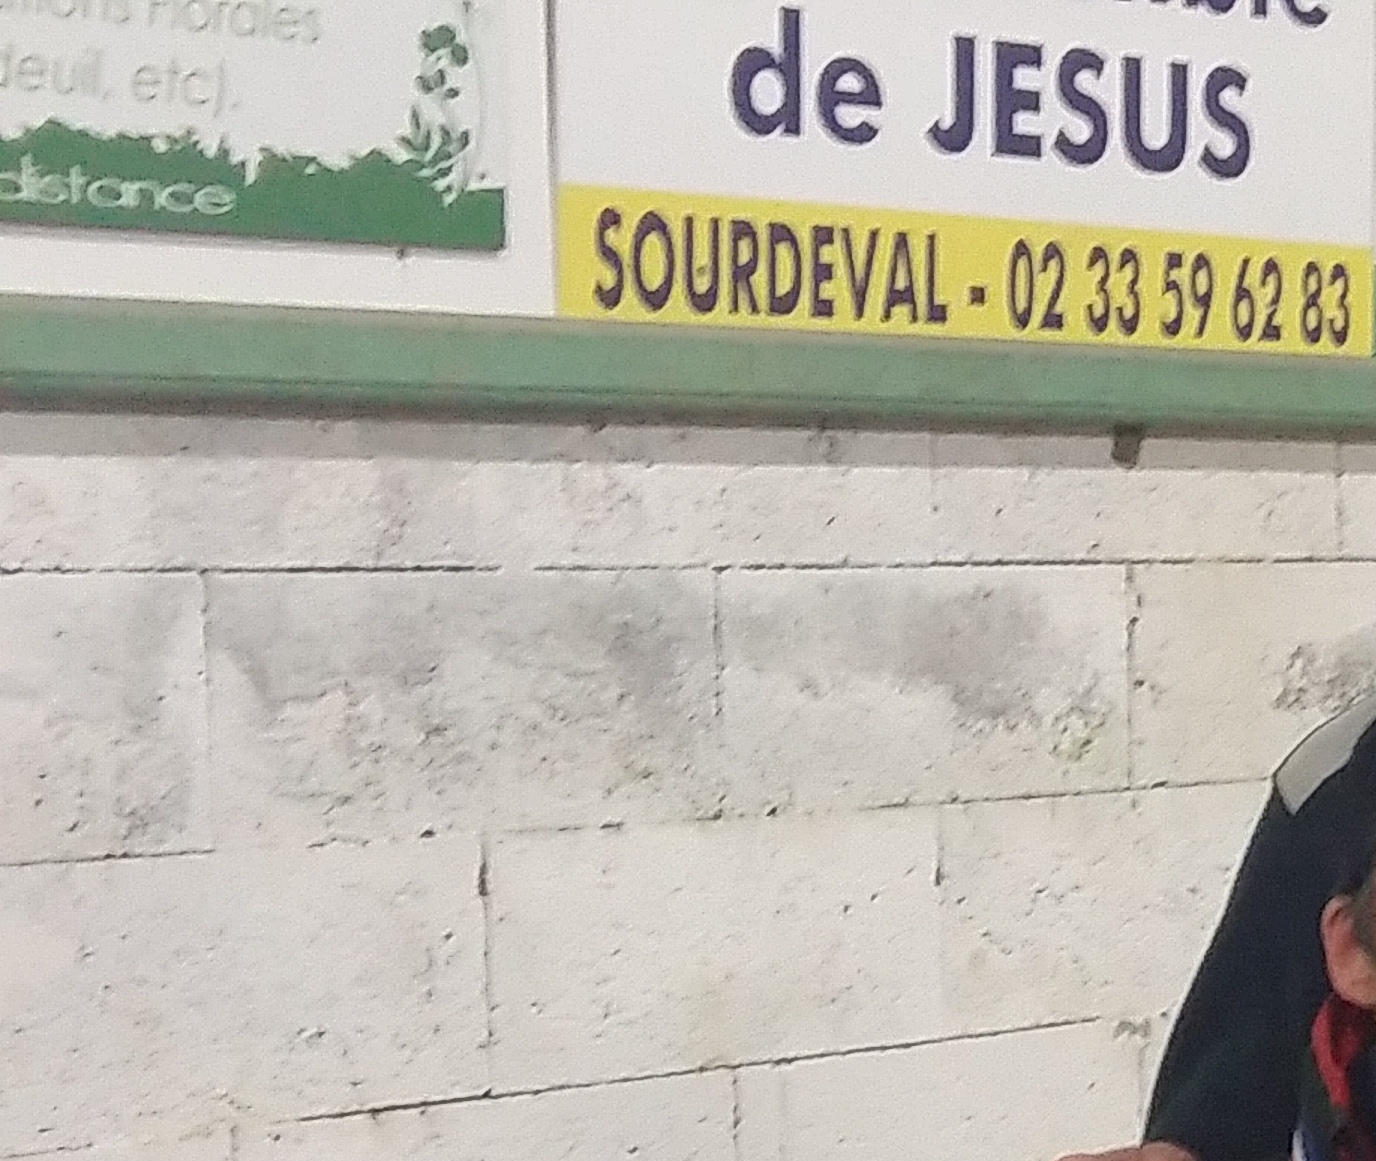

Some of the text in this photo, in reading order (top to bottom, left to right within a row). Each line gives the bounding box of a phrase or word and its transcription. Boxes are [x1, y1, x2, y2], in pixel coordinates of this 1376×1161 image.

[731, 6, 1253, 181] de JESUS
[595, 206, 948, 327] SOURDEVAL
[1009, 238, 1066, 332] 02
[1086, 245, 1141, 338] 33
[1161, 252, 1214, 341] 59
[1232, 256, 1284, 346] 62
[1301, 260, 1352, 348] 83
